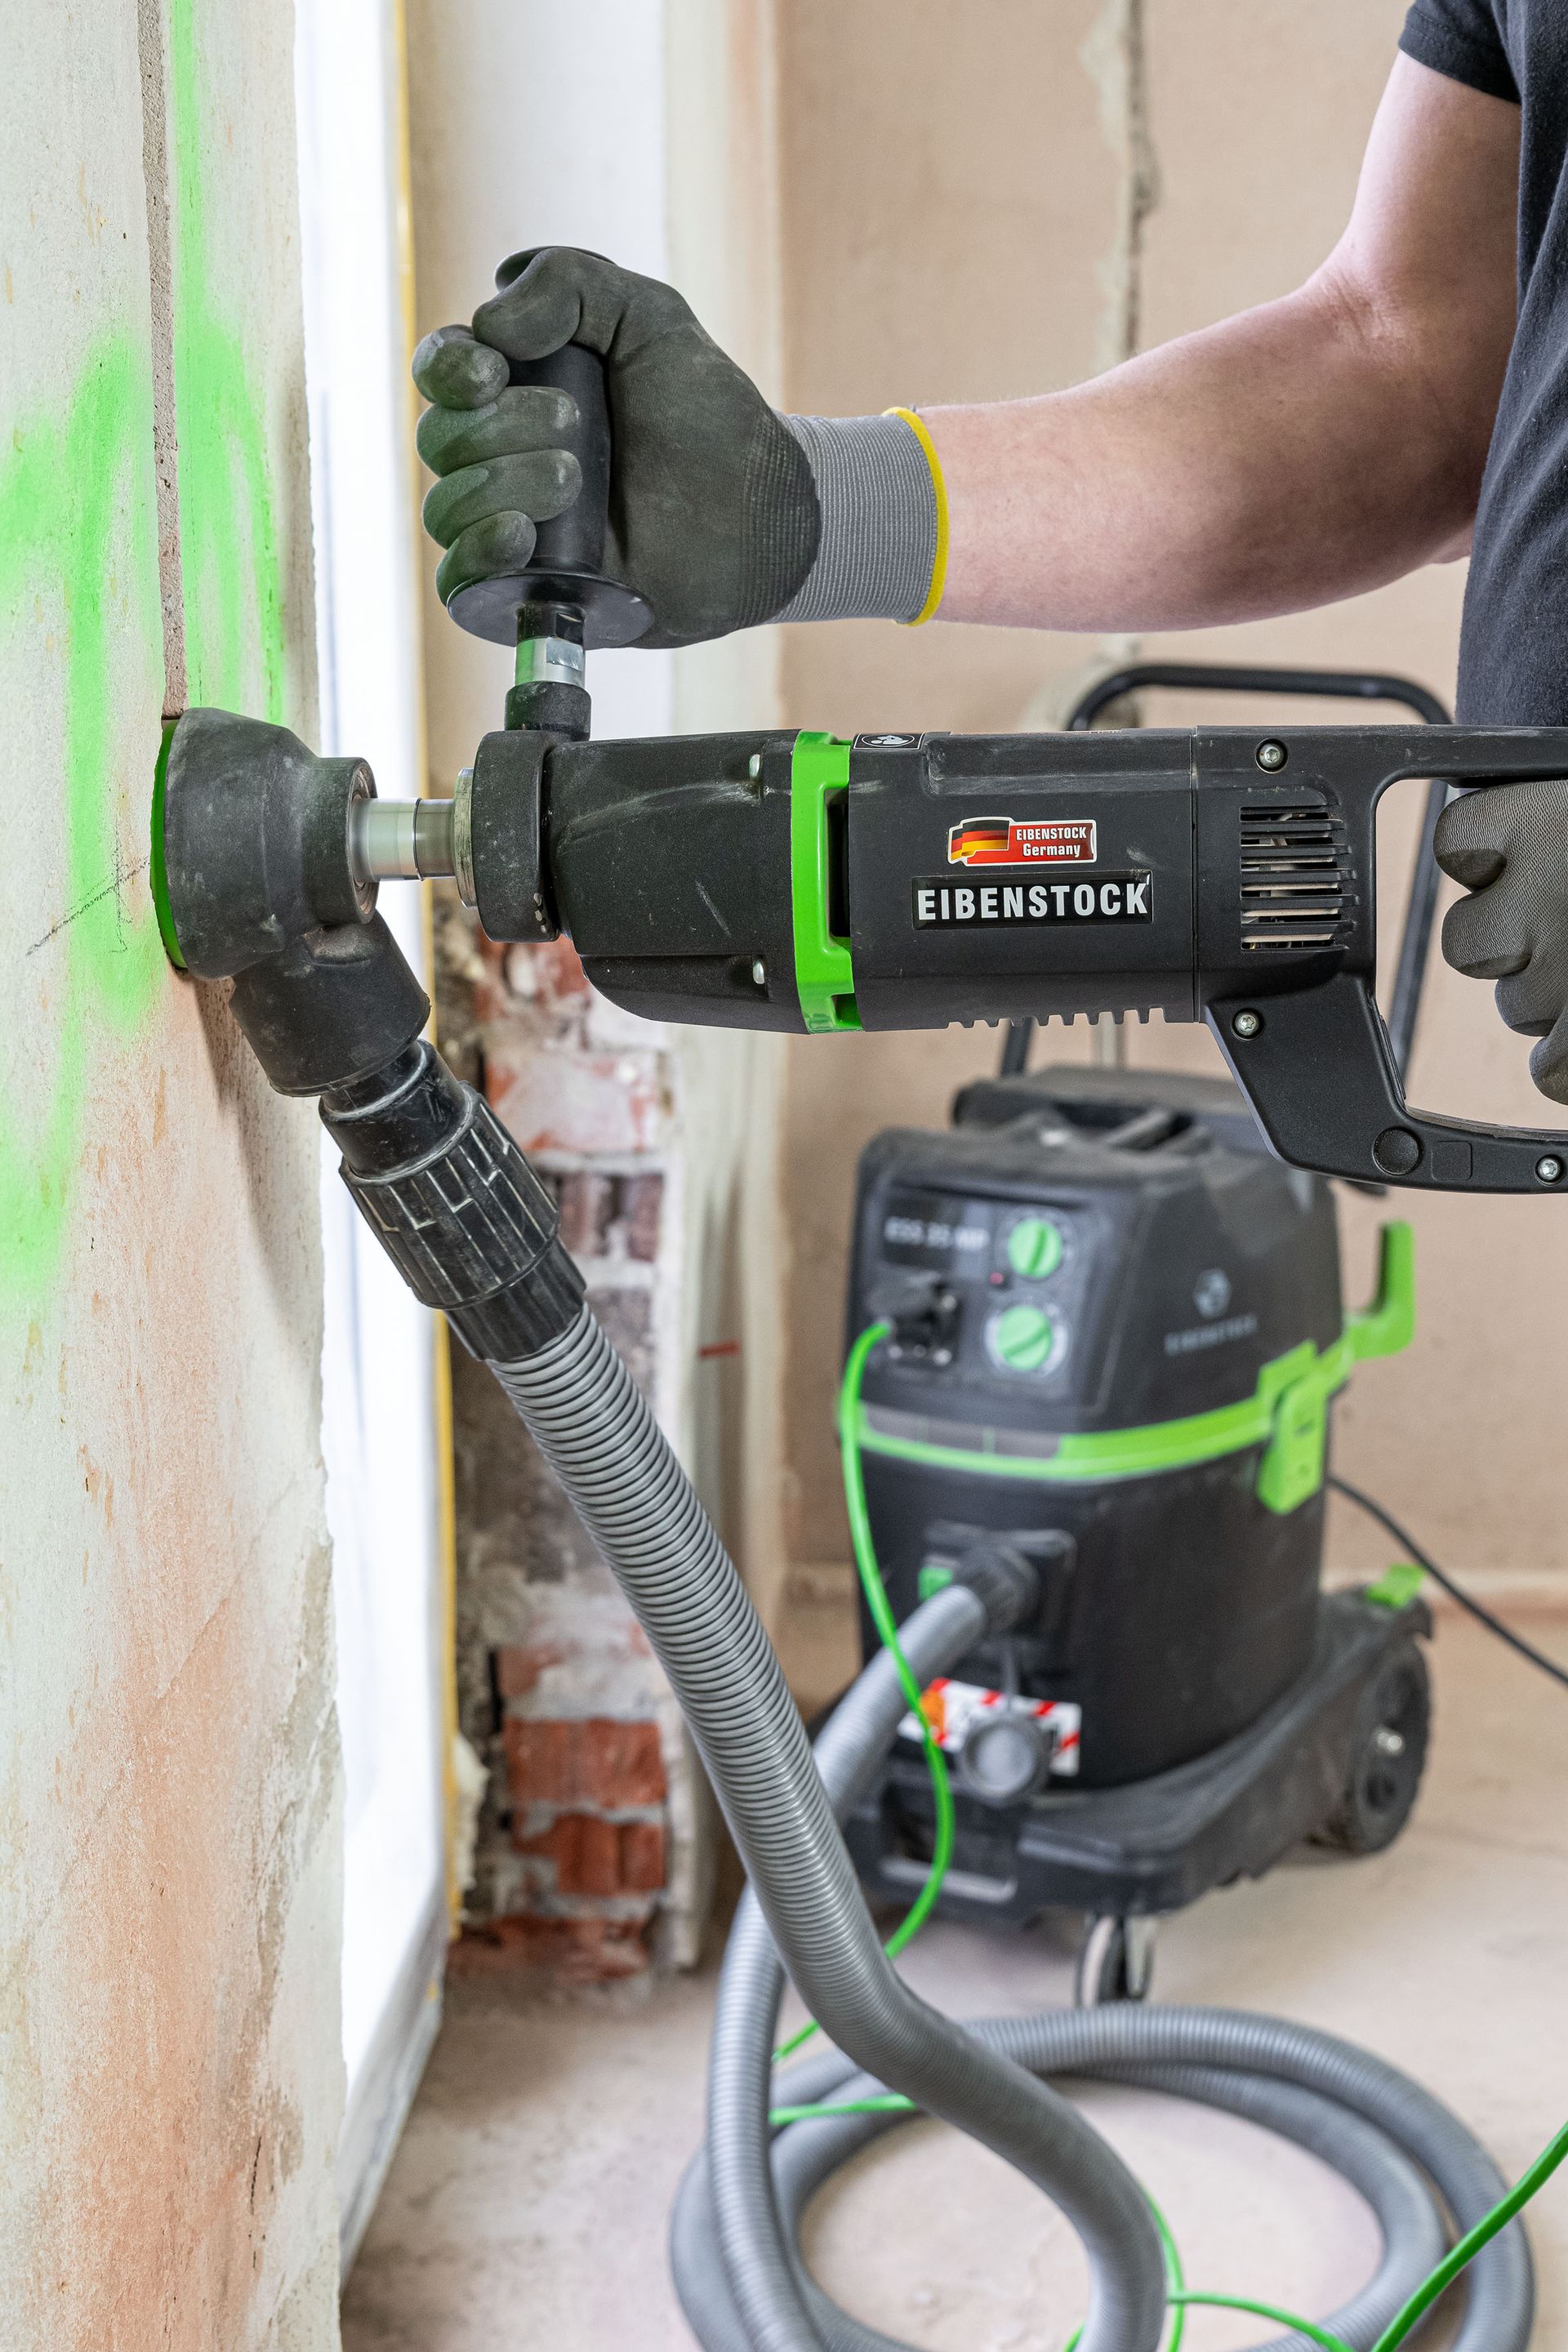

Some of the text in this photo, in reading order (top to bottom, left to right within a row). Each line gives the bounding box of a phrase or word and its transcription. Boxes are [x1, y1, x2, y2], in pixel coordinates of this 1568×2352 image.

[1016, 827, 1087, 840] EIBENSTOCK
[1022, 843, 1080, 858] Germany
[918, 883, 1147, 920] EIBENSTOCK
